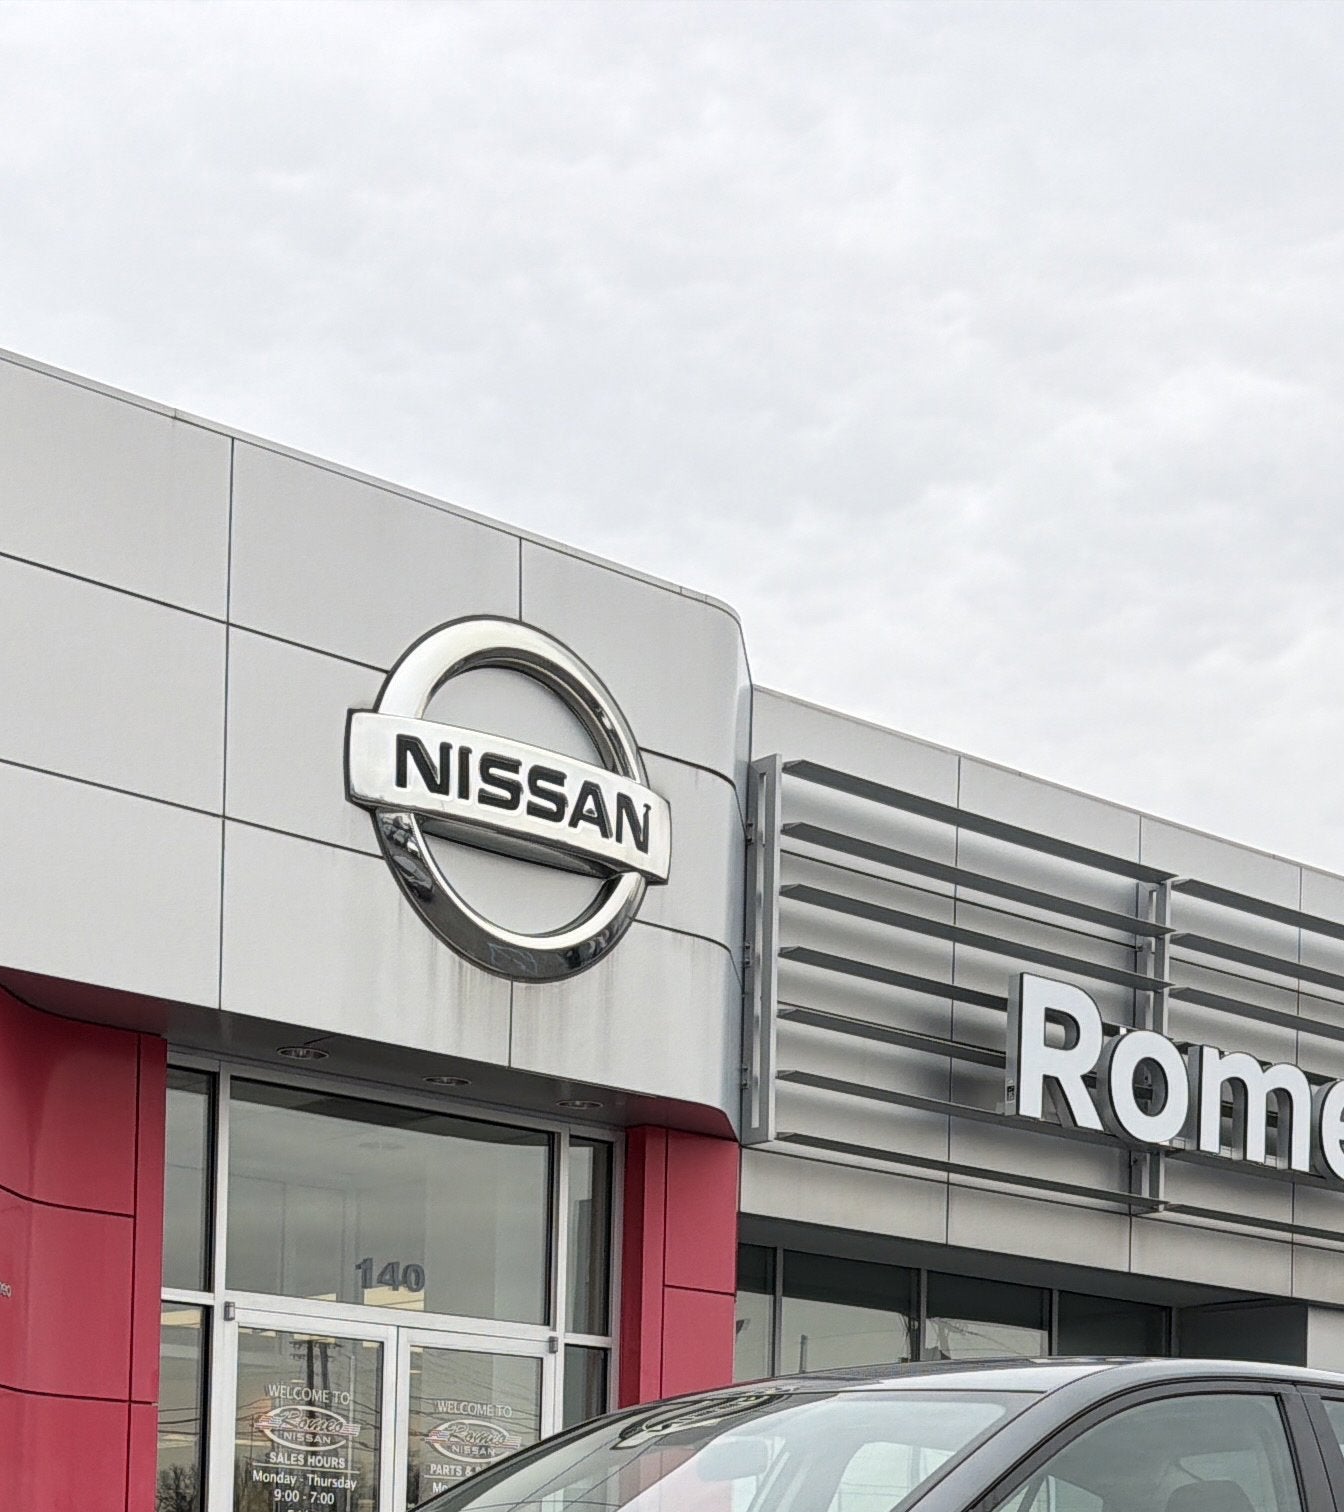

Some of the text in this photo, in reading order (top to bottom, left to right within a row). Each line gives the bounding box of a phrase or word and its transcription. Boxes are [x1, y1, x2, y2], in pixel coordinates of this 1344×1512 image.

[394, 732, 652, 854] NISSAN
[355, 1257, 425, 1293] 140
[268, 1383, 351, 1405] WELCOME TO
[437, 1400, 513, 1418] WELCOME TO
[276, 1407, 345, 1433] Romeo
[283, 1431, 331, 1444] NISSAN
[447, 1422, 508, 1447] Romeo
[269, 1451, 346, 1469] SALES HOURS
[451, 1445, 496, 1457] NISSAN
[430, 1463, 463, 1476] PARTS
[252, 1469, 297, 1486] Monday
[306, 1473, 357, 1491] Thursday
[273, 1489, 300, 1502] 9:00
[310, 1491, 335, 1505] 7:00
